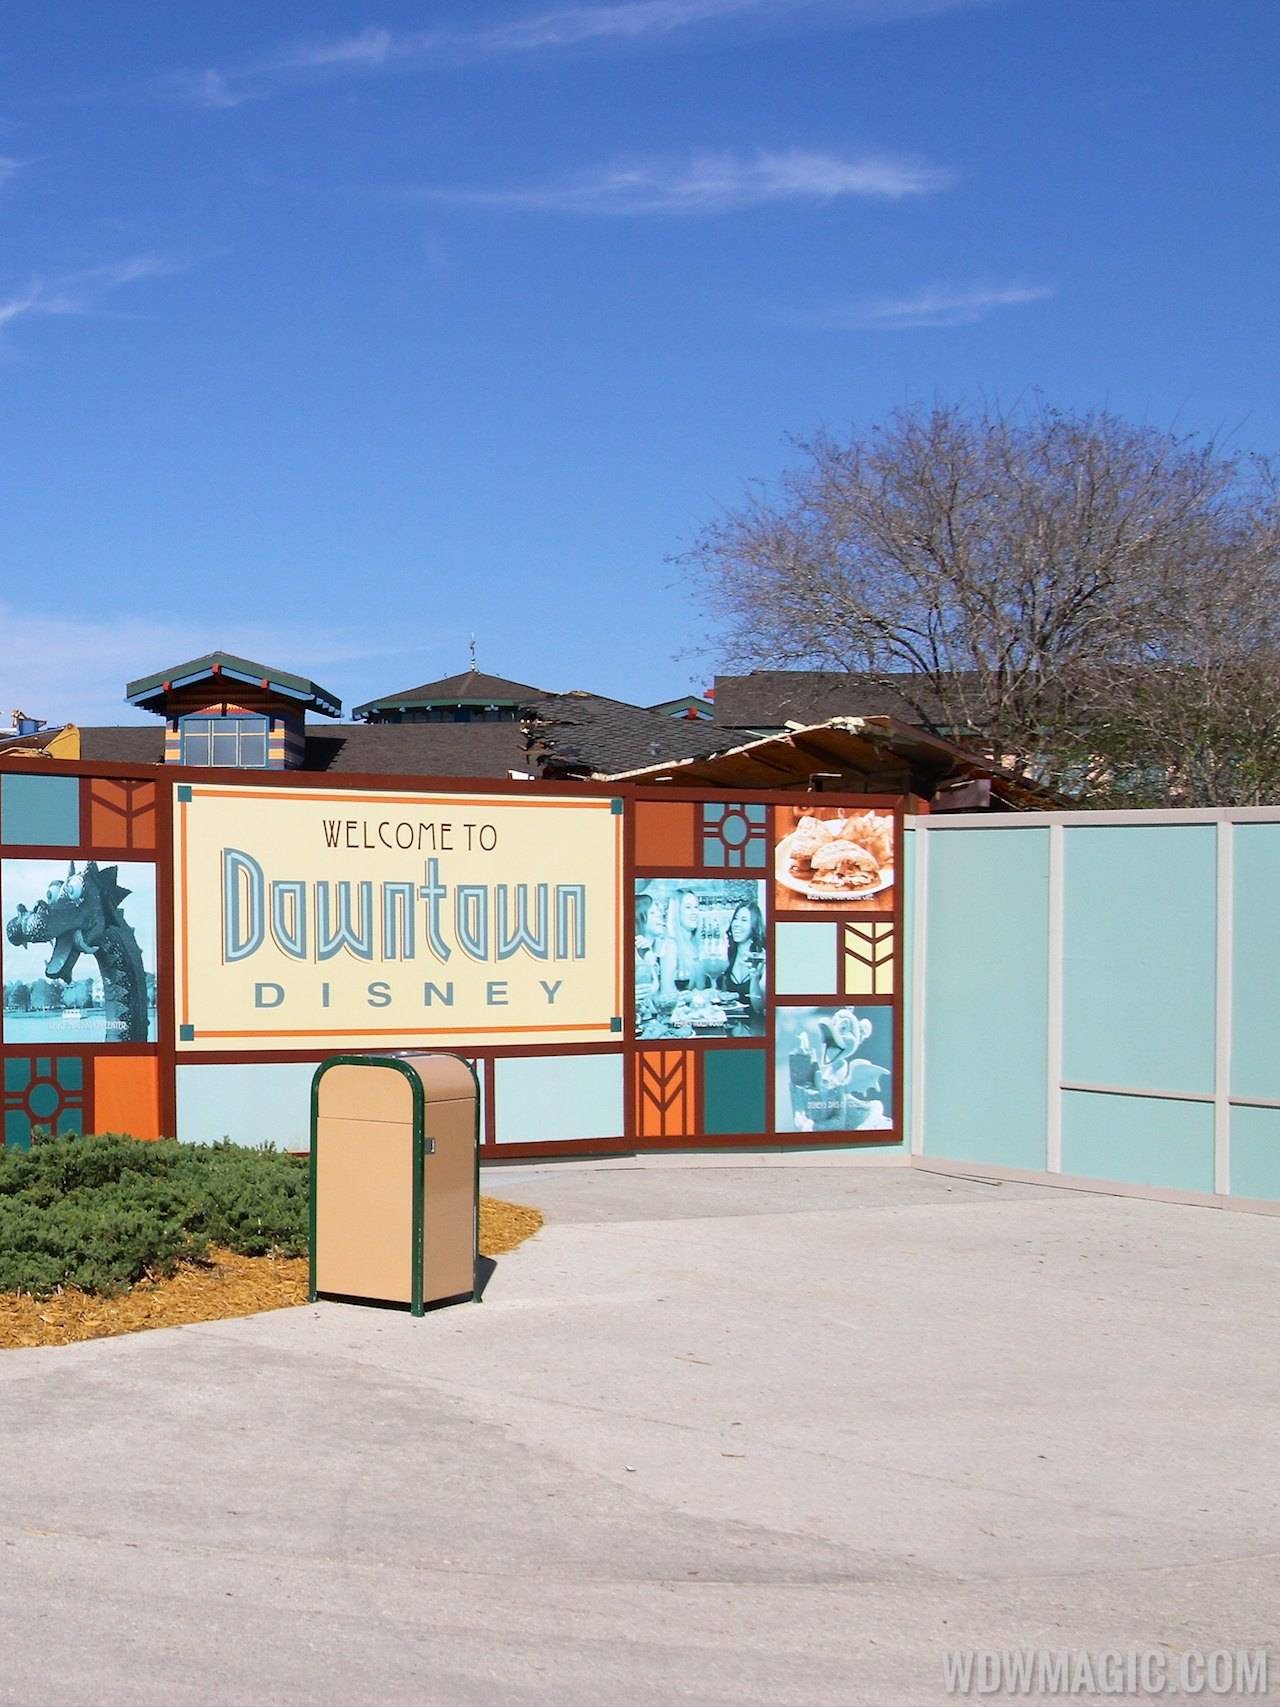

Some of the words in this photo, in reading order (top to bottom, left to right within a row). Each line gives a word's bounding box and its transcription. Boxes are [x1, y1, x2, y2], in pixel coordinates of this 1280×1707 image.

[322, 819, 453, 851] WELCOME
[464, 824, 497, 852] TO
[221, 847, 586, 965] Downtown
[254, 980, 563, 1009] DISNEY
